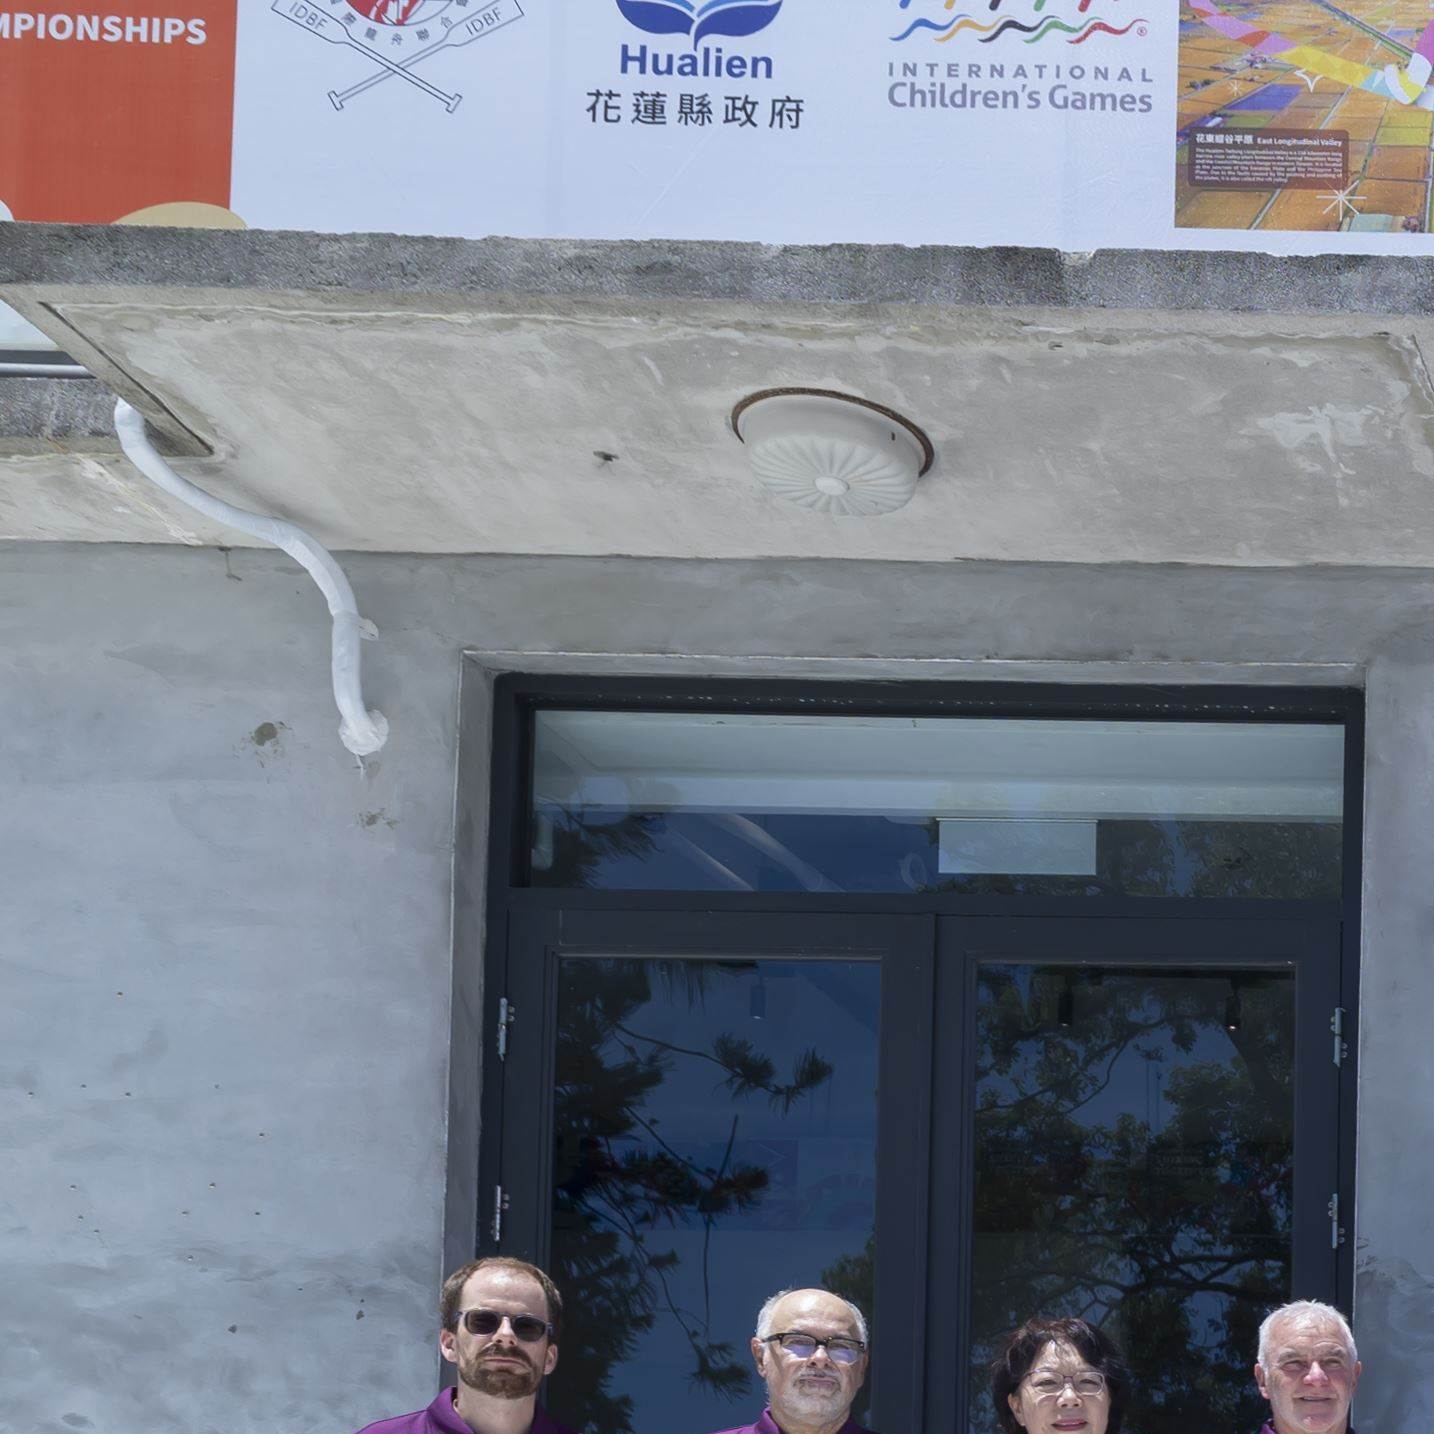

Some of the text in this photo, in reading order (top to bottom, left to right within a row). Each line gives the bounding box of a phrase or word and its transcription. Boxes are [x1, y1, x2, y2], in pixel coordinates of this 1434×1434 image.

[288, 1, 327, 31] IDBF
[464, 7, 504, 36] IDBF
[620, 44, 773, 79] Hualien
[888, 62, 1153, 83] INTERNATIONAL
[585, 89, 804, 129] 花蓮縣政府
[888, 82, 1153, 113] Children's Games
[1257, 137, 1273, 145] East
